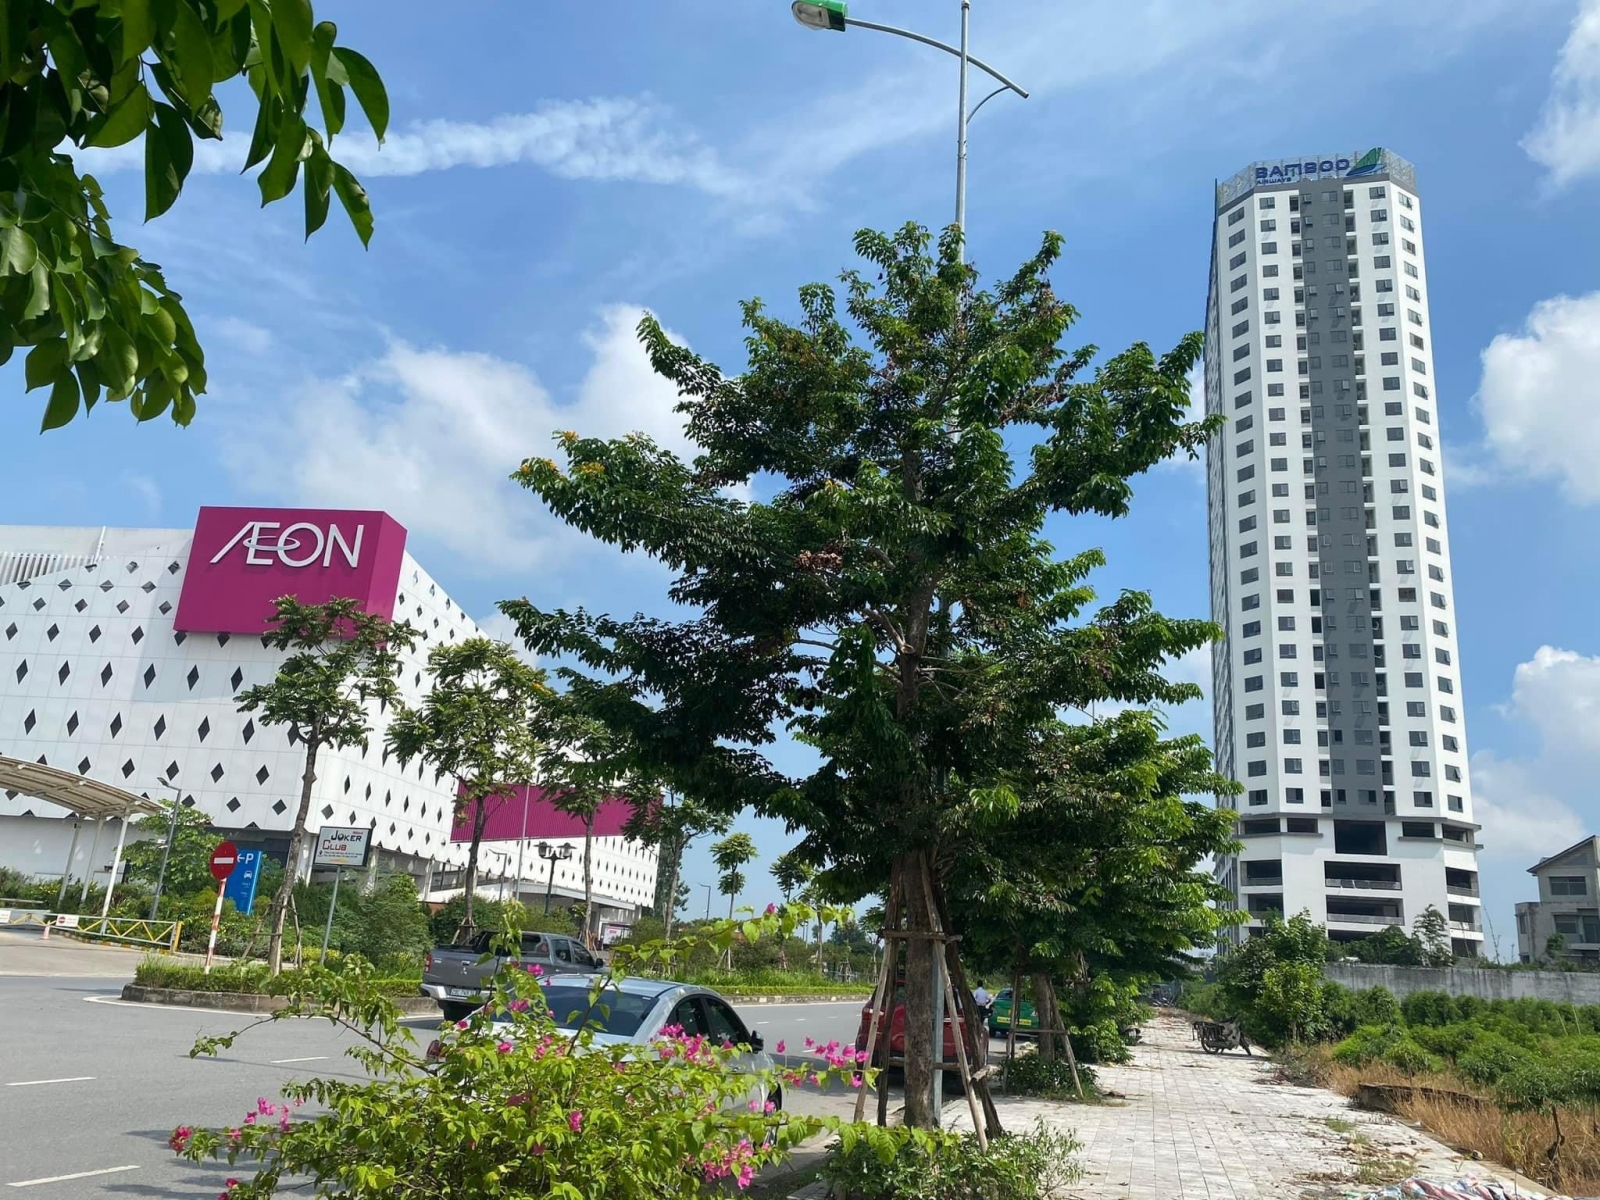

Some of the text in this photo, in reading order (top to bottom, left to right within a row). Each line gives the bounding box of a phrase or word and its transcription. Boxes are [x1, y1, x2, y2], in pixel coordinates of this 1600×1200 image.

[1255, 158, 1350, 178] BAMBOO
[1256, 177, 1292, 185] AIRWAYS
[330, 829, 362, 842] JOKER
[322, 839, 347, 851] CLUB
[245, 852, 254, 865] P
